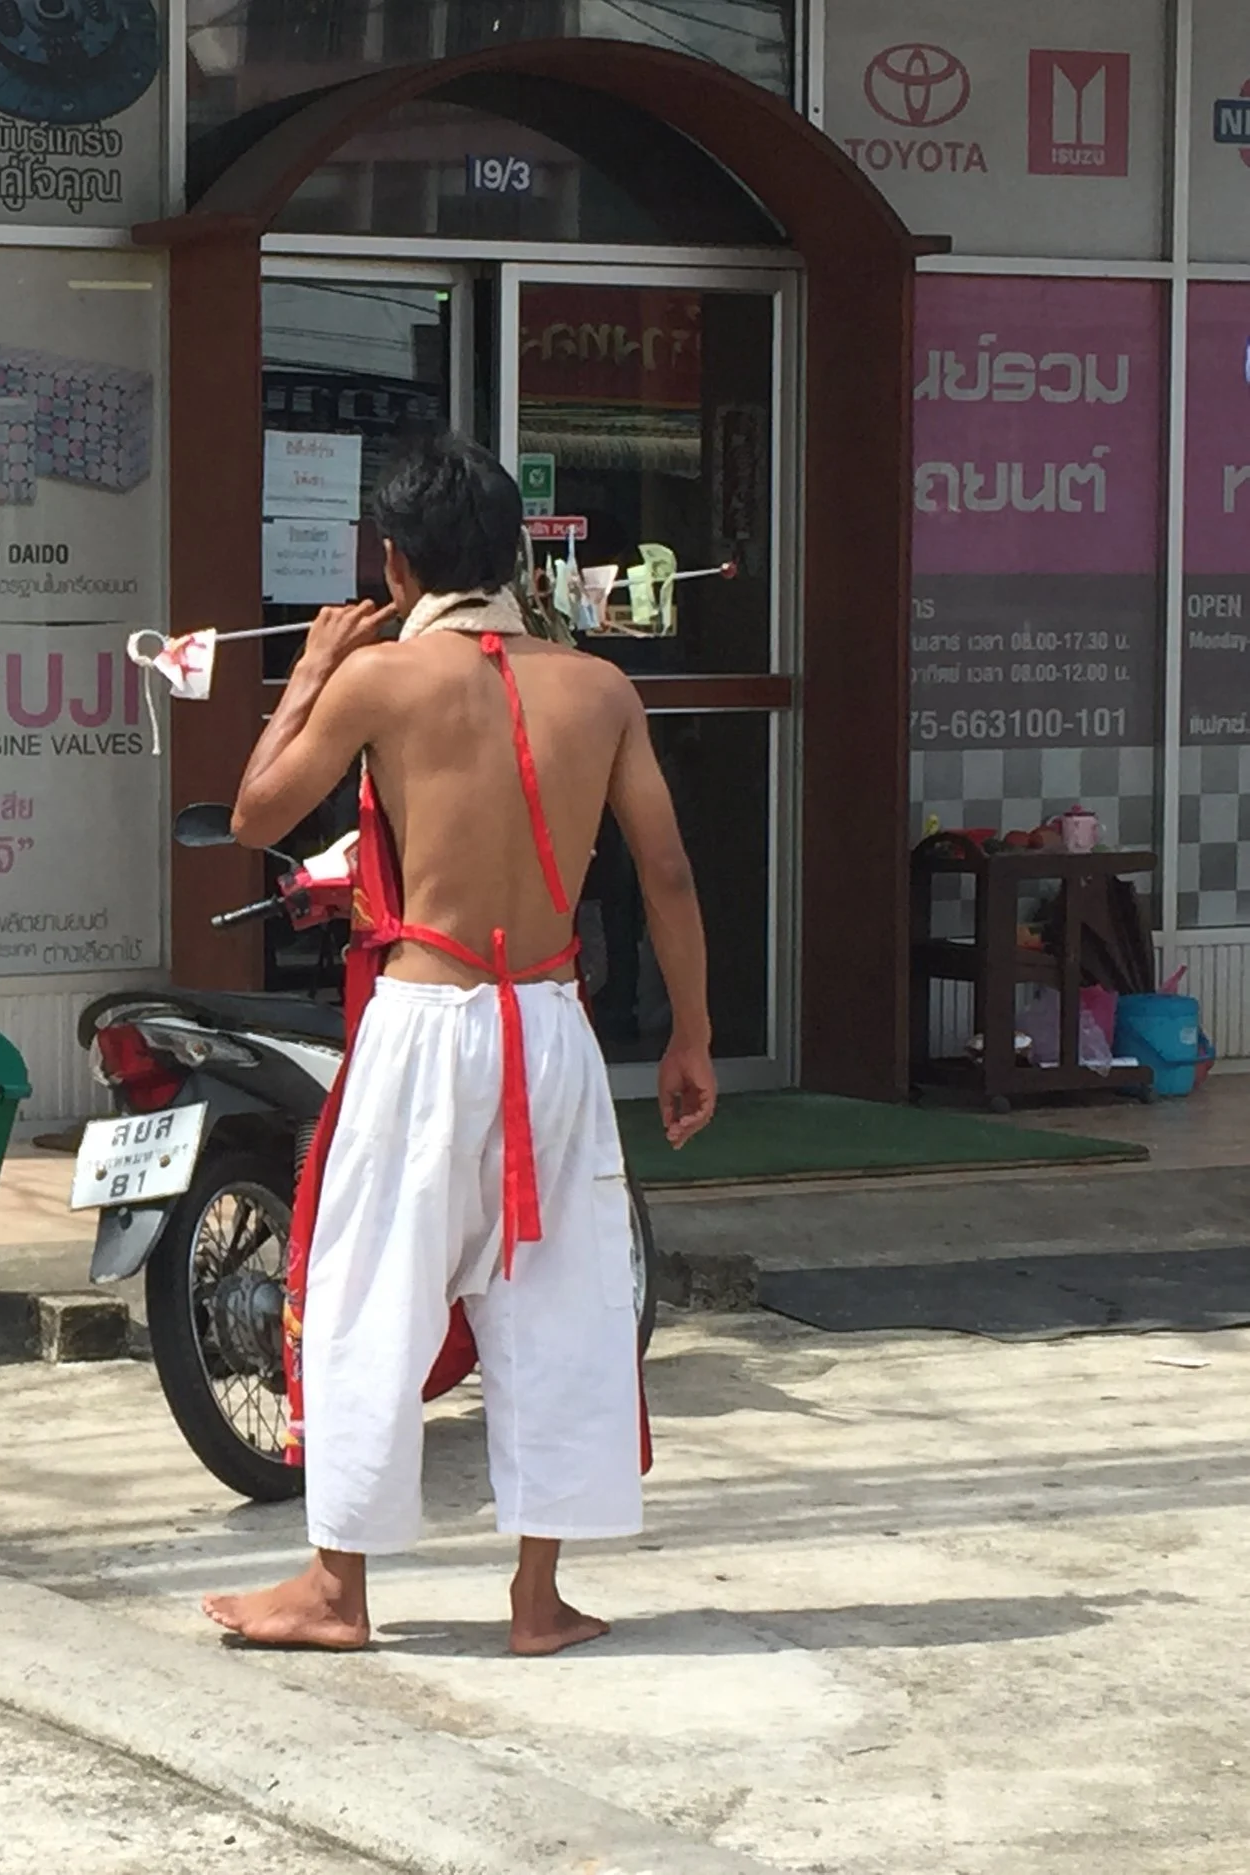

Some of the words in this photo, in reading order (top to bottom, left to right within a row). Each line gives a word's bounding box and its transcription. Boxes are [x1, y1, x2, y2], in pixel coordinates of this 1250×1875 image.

[844, 138, 989, 174] TOYOTA
[1051, 147, 1105, 165] ISUZU
[473, 157, 531, 192] 19/3
[8, 543, 70, 564] DAIDO
[1187, 594, 1242, 618] OPEN
[52, 733, 144, 756] VALVES
[109, 1169, 148, 1199] 81
